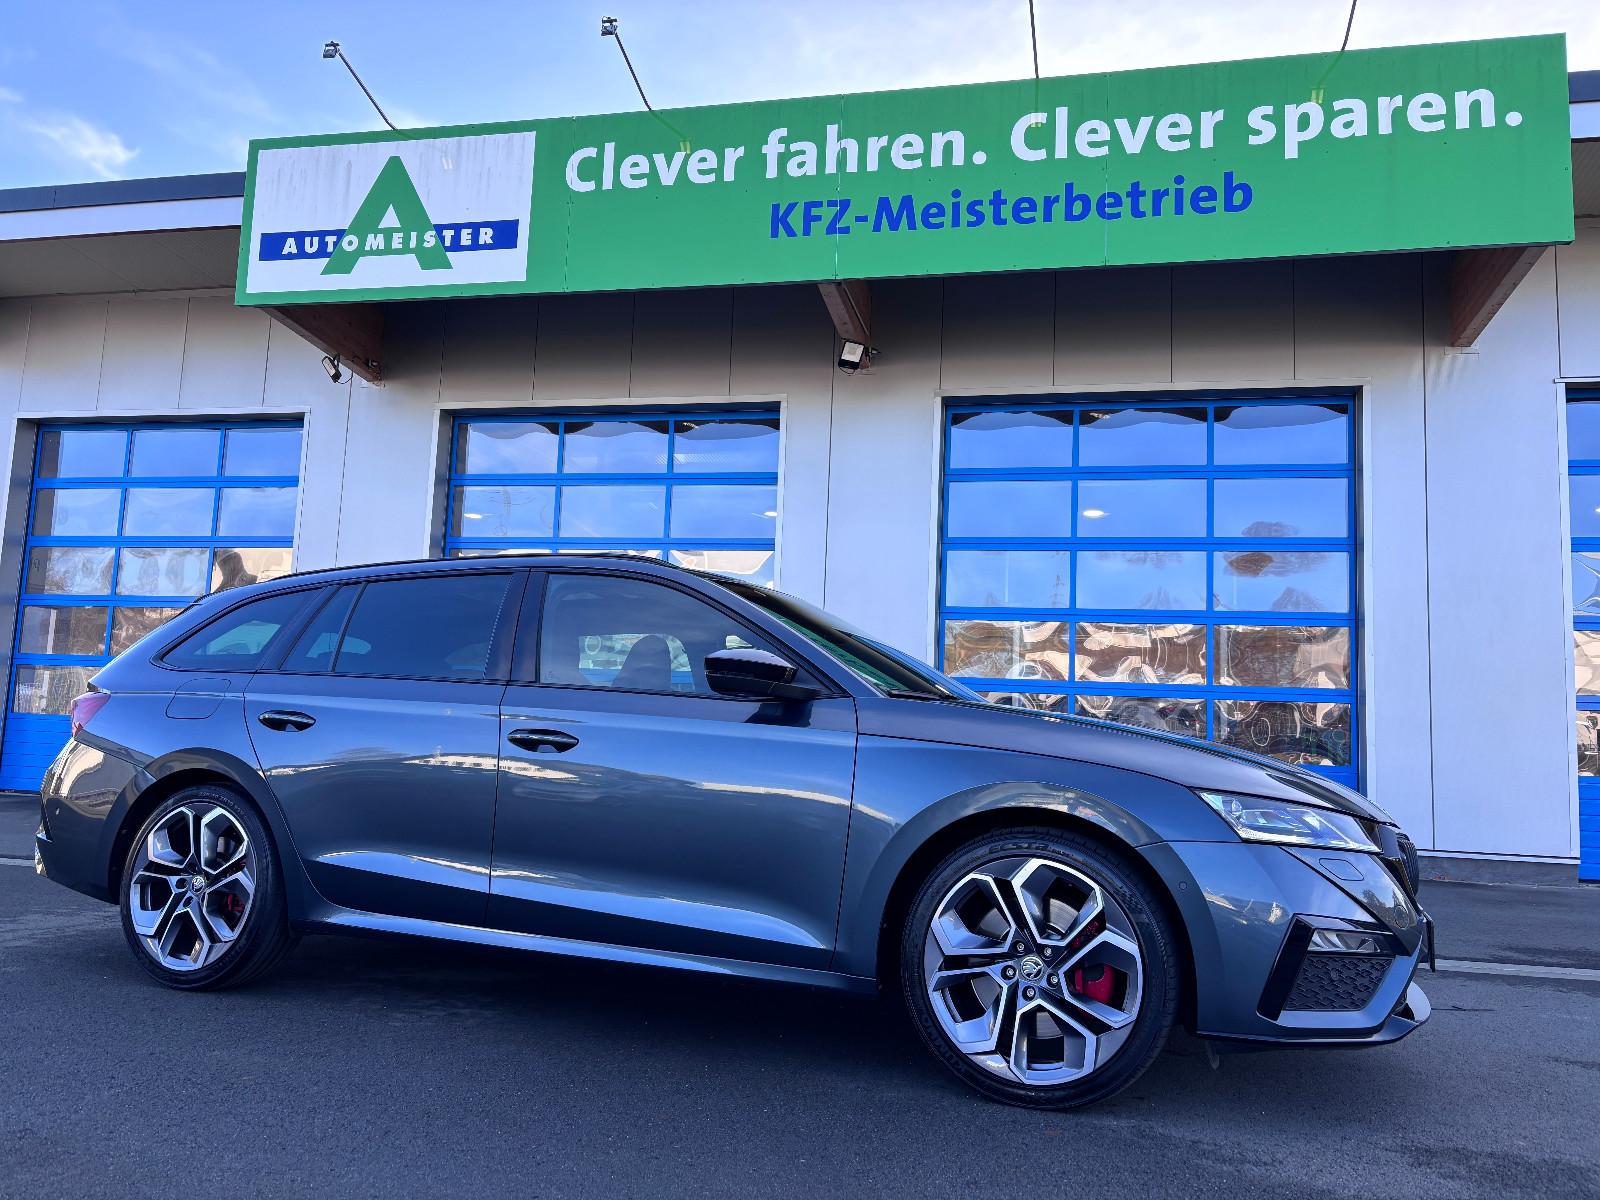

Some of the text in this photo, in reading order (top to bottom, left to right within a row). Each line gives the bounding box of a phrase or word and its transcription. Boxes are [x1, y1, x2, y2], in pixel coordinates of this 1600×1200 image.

[565, 88, 1523, 193] Clever fahren. Clever sparen.
[770, 172, 1253, 238] KFZ-Meisterbetrieb
[281, 227, 494, 255] AUTOMEISTER
